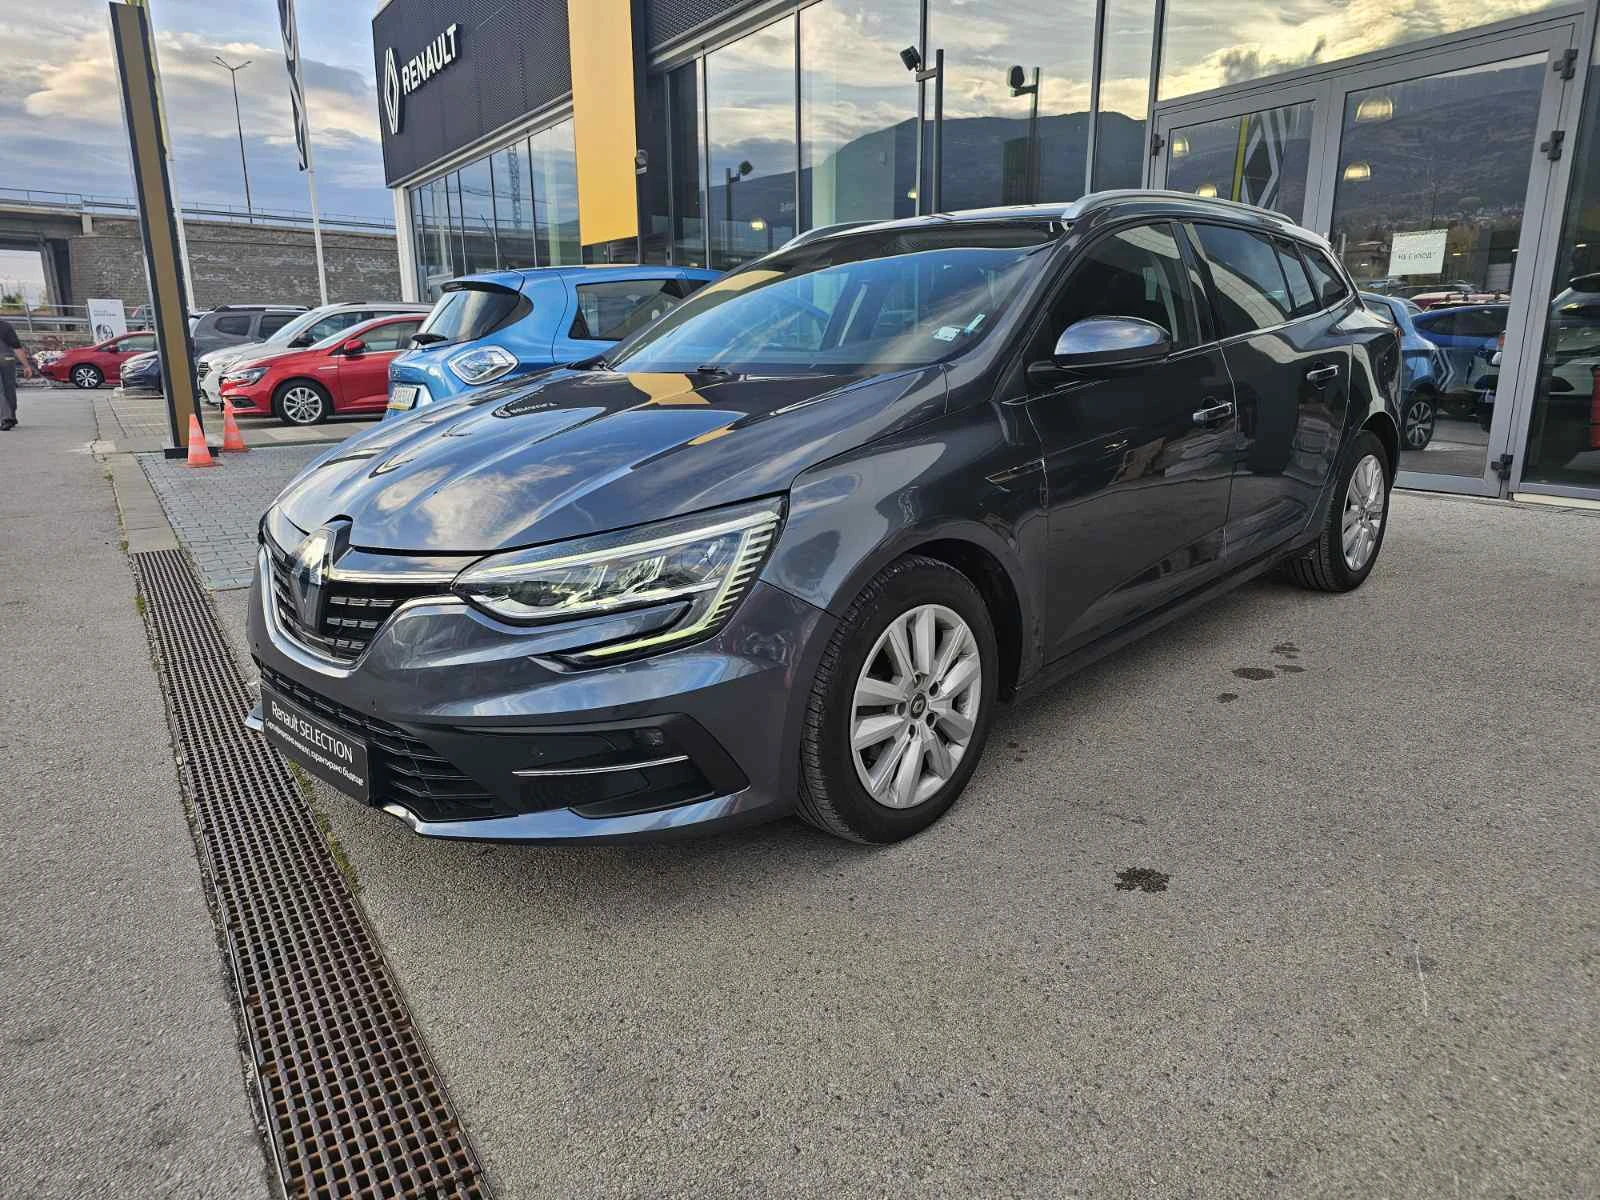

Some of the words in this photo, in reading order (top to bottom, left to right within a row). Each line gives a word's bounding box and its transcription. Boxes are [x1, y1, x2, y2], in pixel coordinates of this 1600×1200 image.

[401, 23, 457, 96] RENAULT
[271, 700, 299, 733] Renault
[299, 719, 353, 764] SELECTION
